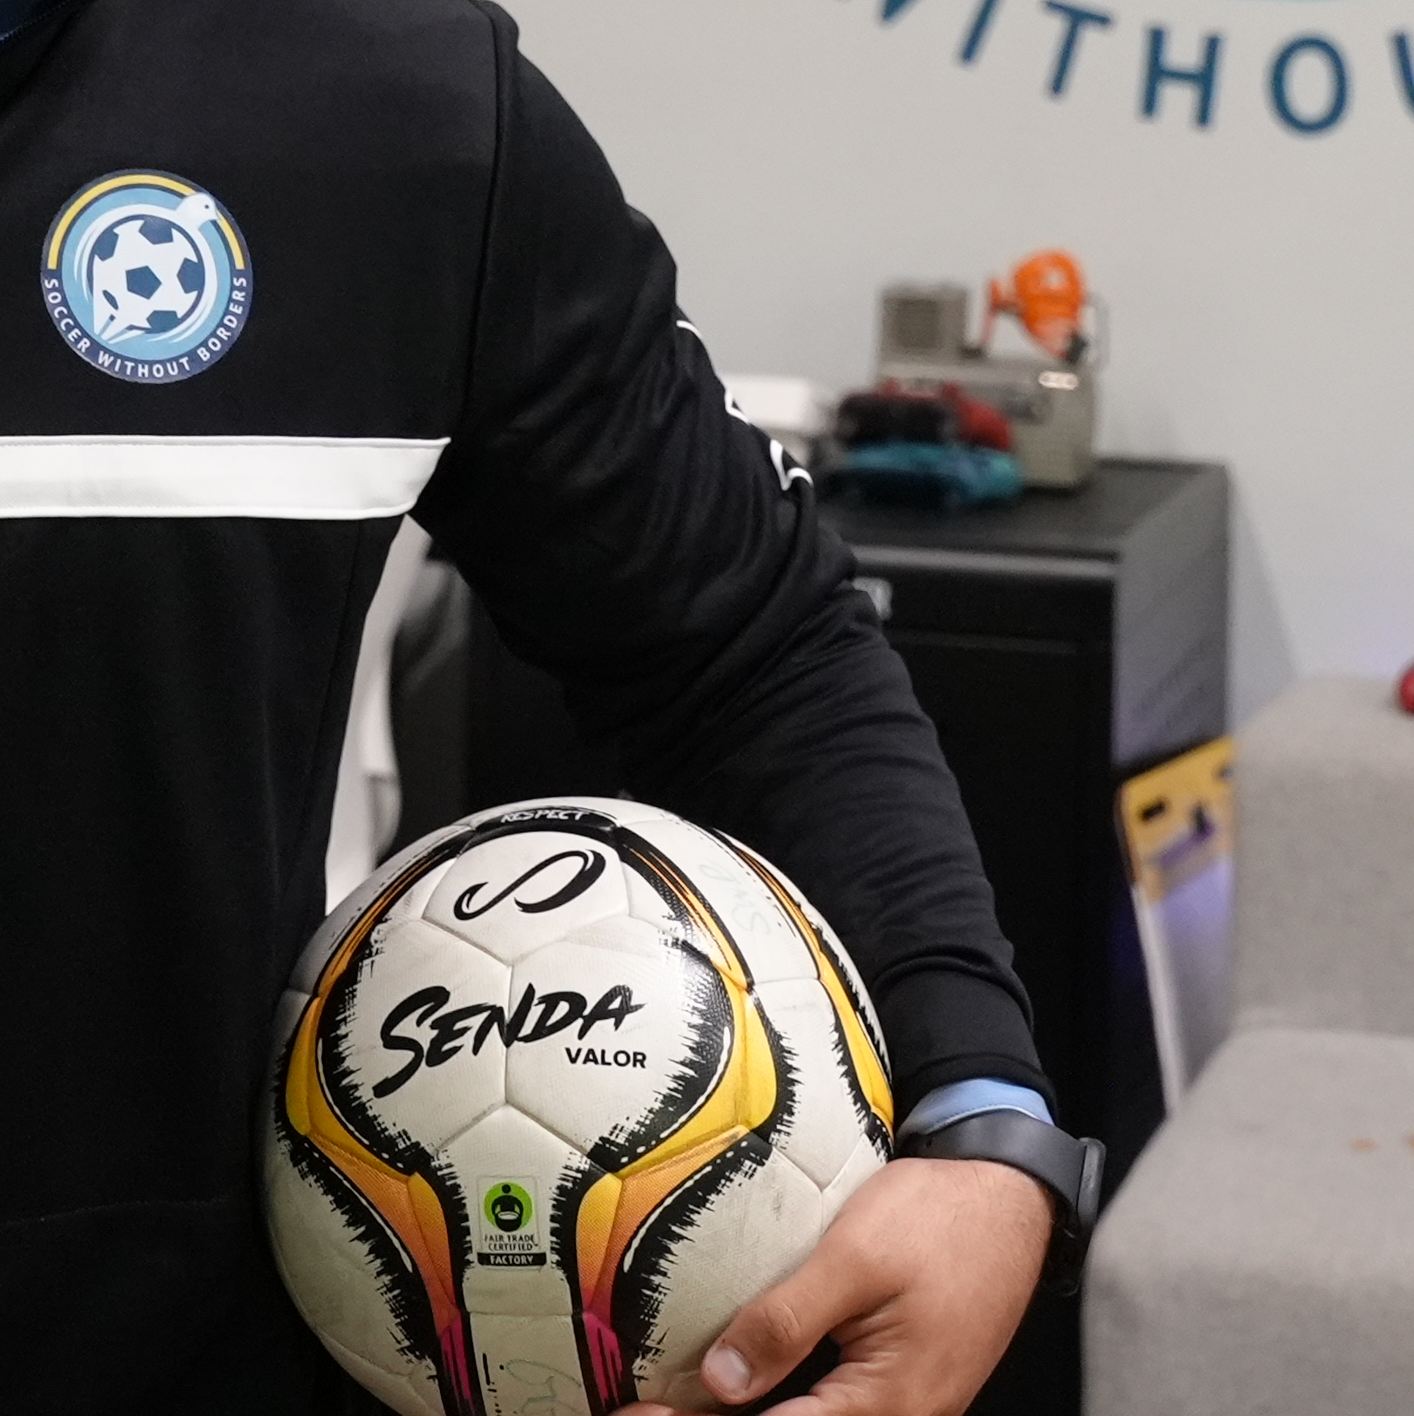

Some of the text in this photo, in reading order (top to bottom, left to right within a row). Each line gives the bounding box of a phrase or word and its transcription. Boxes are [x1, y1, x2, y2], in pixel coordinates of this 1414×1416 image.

[44, 276, 247, 378] SOCCER WITHOUT BORDERS
[500, 809, 586, 823] RESPECT
[372, 981, 646, 1100] SENDA
[564, 1046, 648, 1070] VALOR
[488, 1243, 533, 1252] CERTIFIED
[489, 1254, 534, 1265] FACTORY
